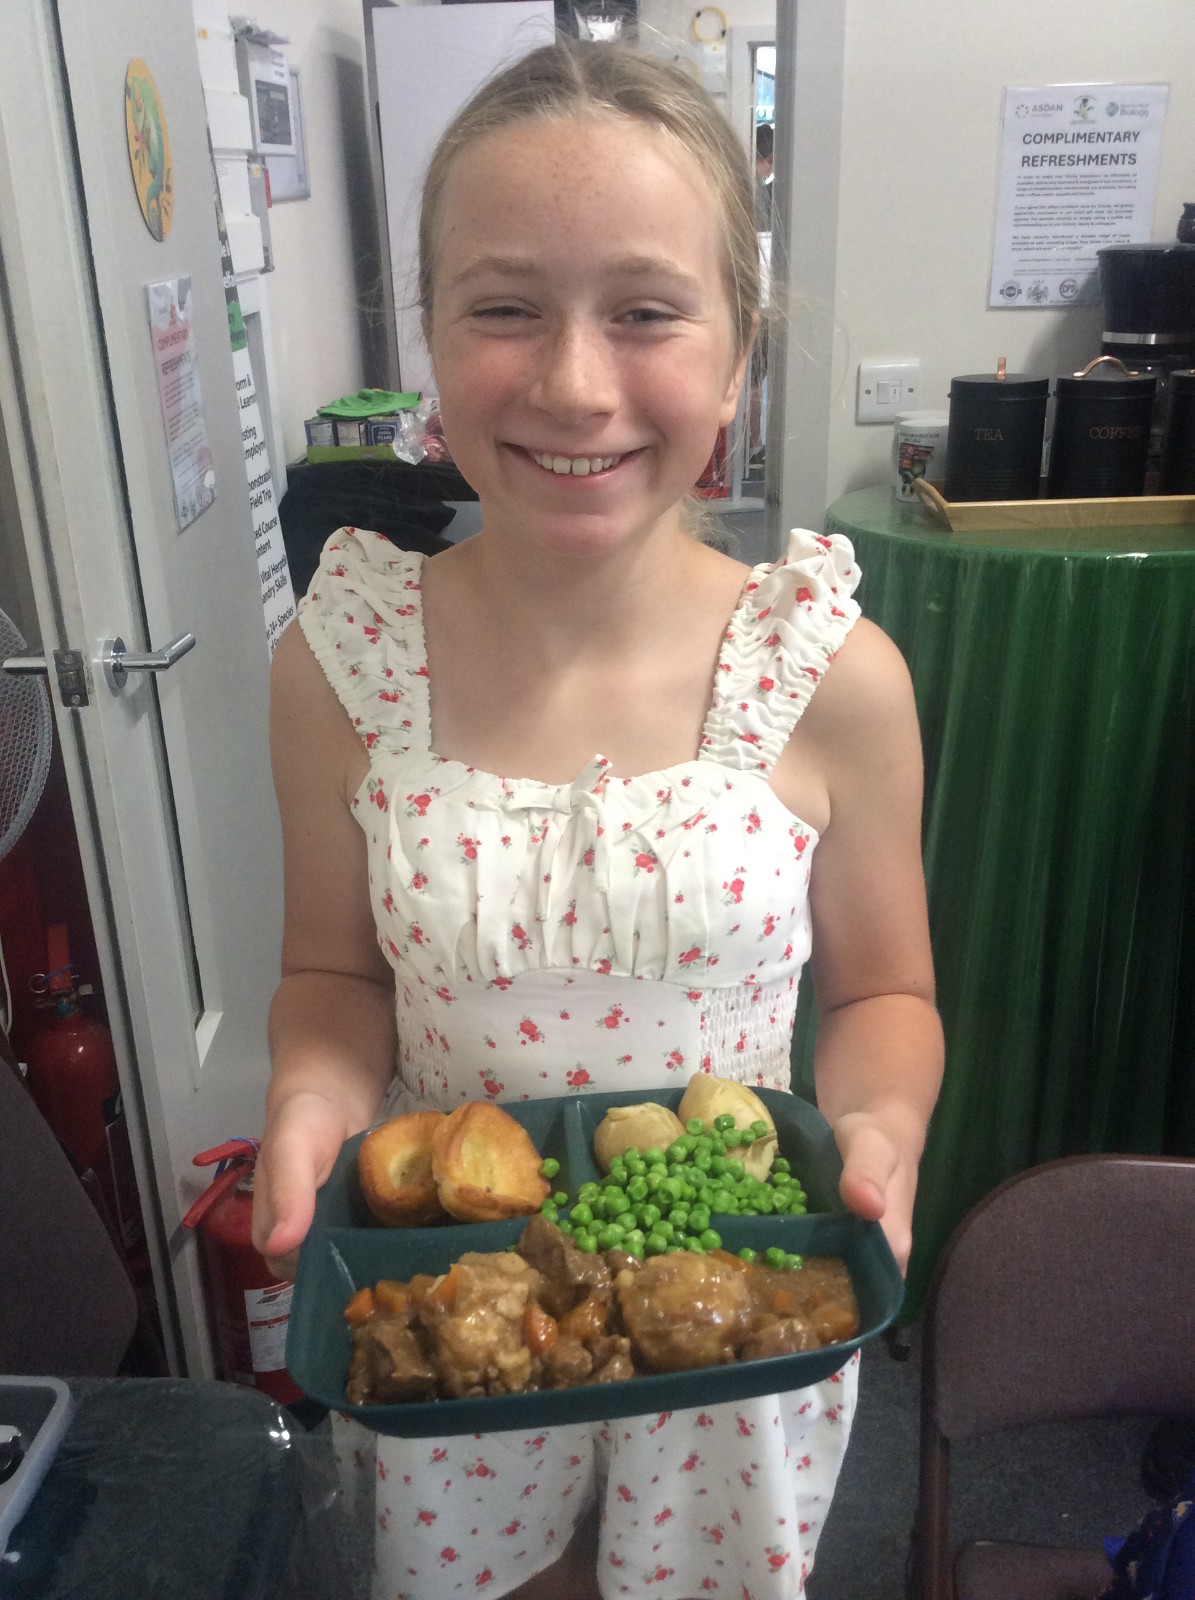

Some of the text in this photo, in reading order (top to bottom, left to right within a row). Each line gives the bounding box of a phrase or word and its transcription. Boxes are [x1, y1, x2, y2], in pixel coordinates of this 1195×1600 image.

[1031, 104, 1064, 112] ASDAN
[1022, 131, 1141, 145] COMPLIMENTARY
[1021, 153, 1137, 168] REFRESHMENTS
[974, 428, 1004, 441] TEA
[249, 487, 272, 510] Field Trip
[261, 515, 279, 534] Course
[275, 575, 288, 592] Skills
[277, 606, 294, 628] Species
